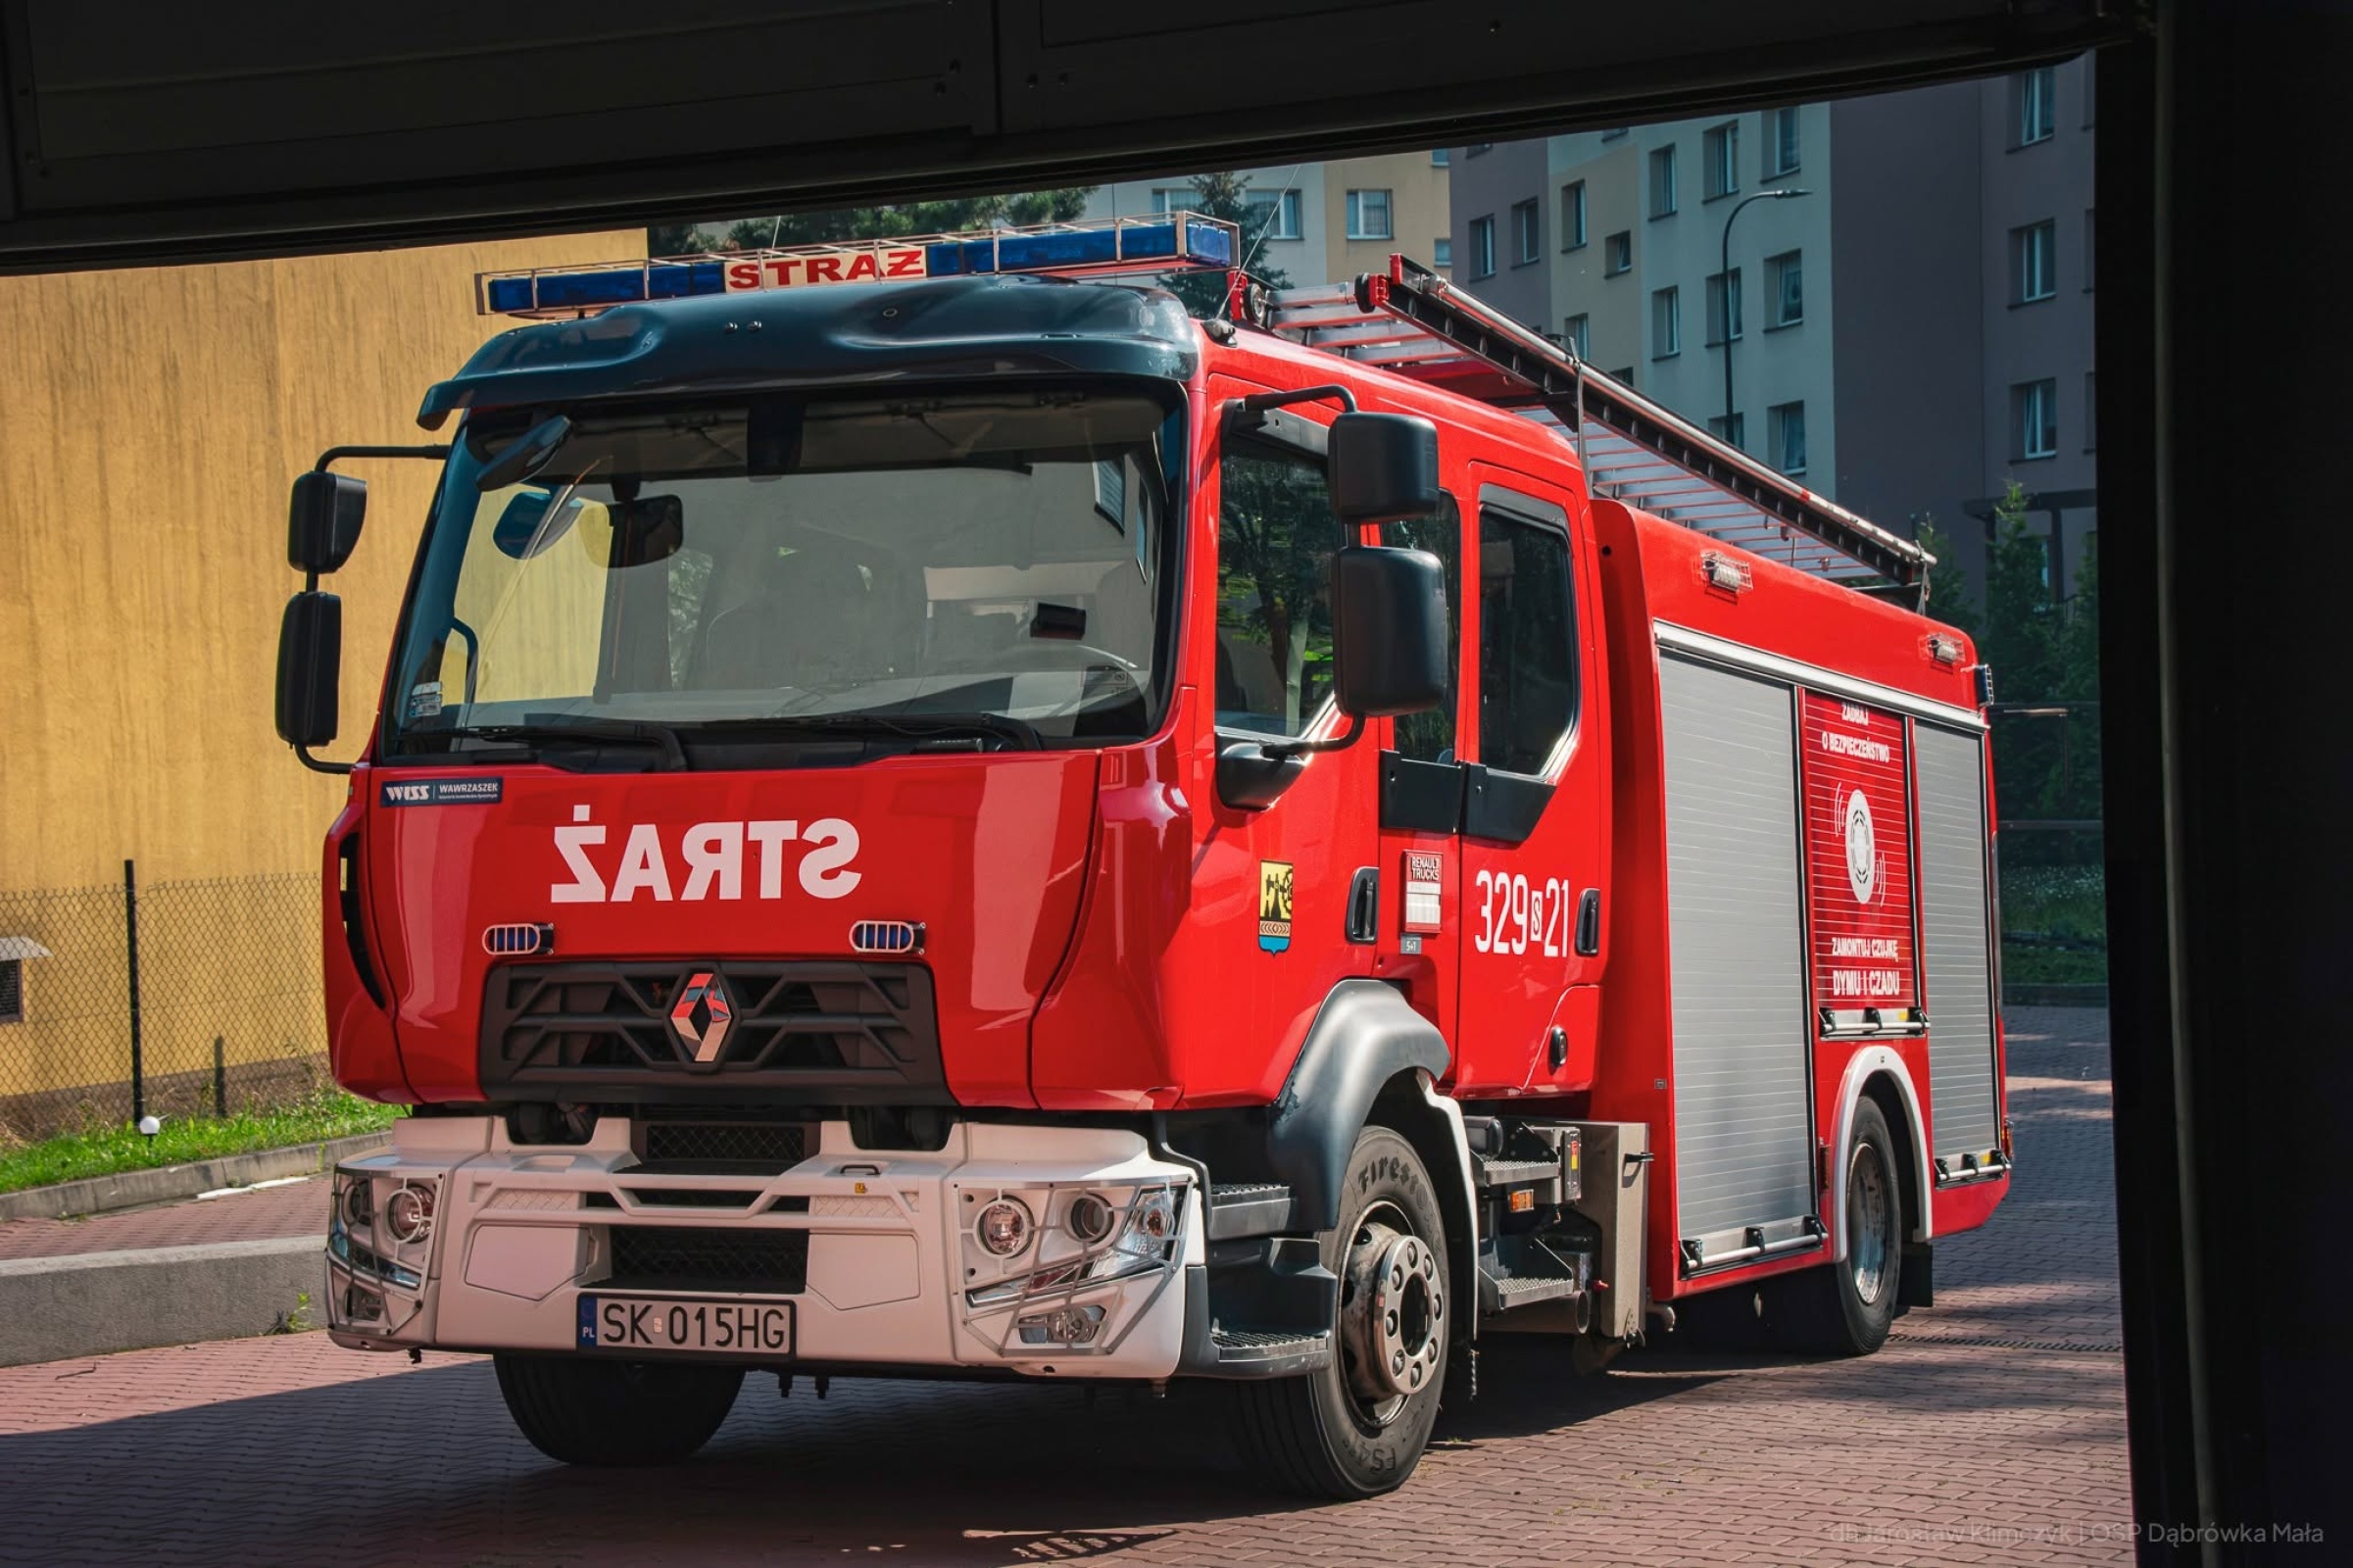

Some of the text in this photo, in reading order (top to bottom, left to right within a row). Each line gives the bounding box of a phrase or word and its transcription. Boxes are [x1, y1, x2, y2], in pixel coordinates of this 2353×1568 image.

[385, 785, 429, 801] WISS
[439, 783, 498, 794] WAWRZASZEK
[1411, 857, 1441, 869] RENAULT
[1411, 867, 1440, 880] TRUCKS
[1832, 937, 1871, 956] ZAMONTUJ
[1833, 970, 1900, 996] DYMU I CZADU
[582, 1303, 785, 1349] PL SK 015HG
